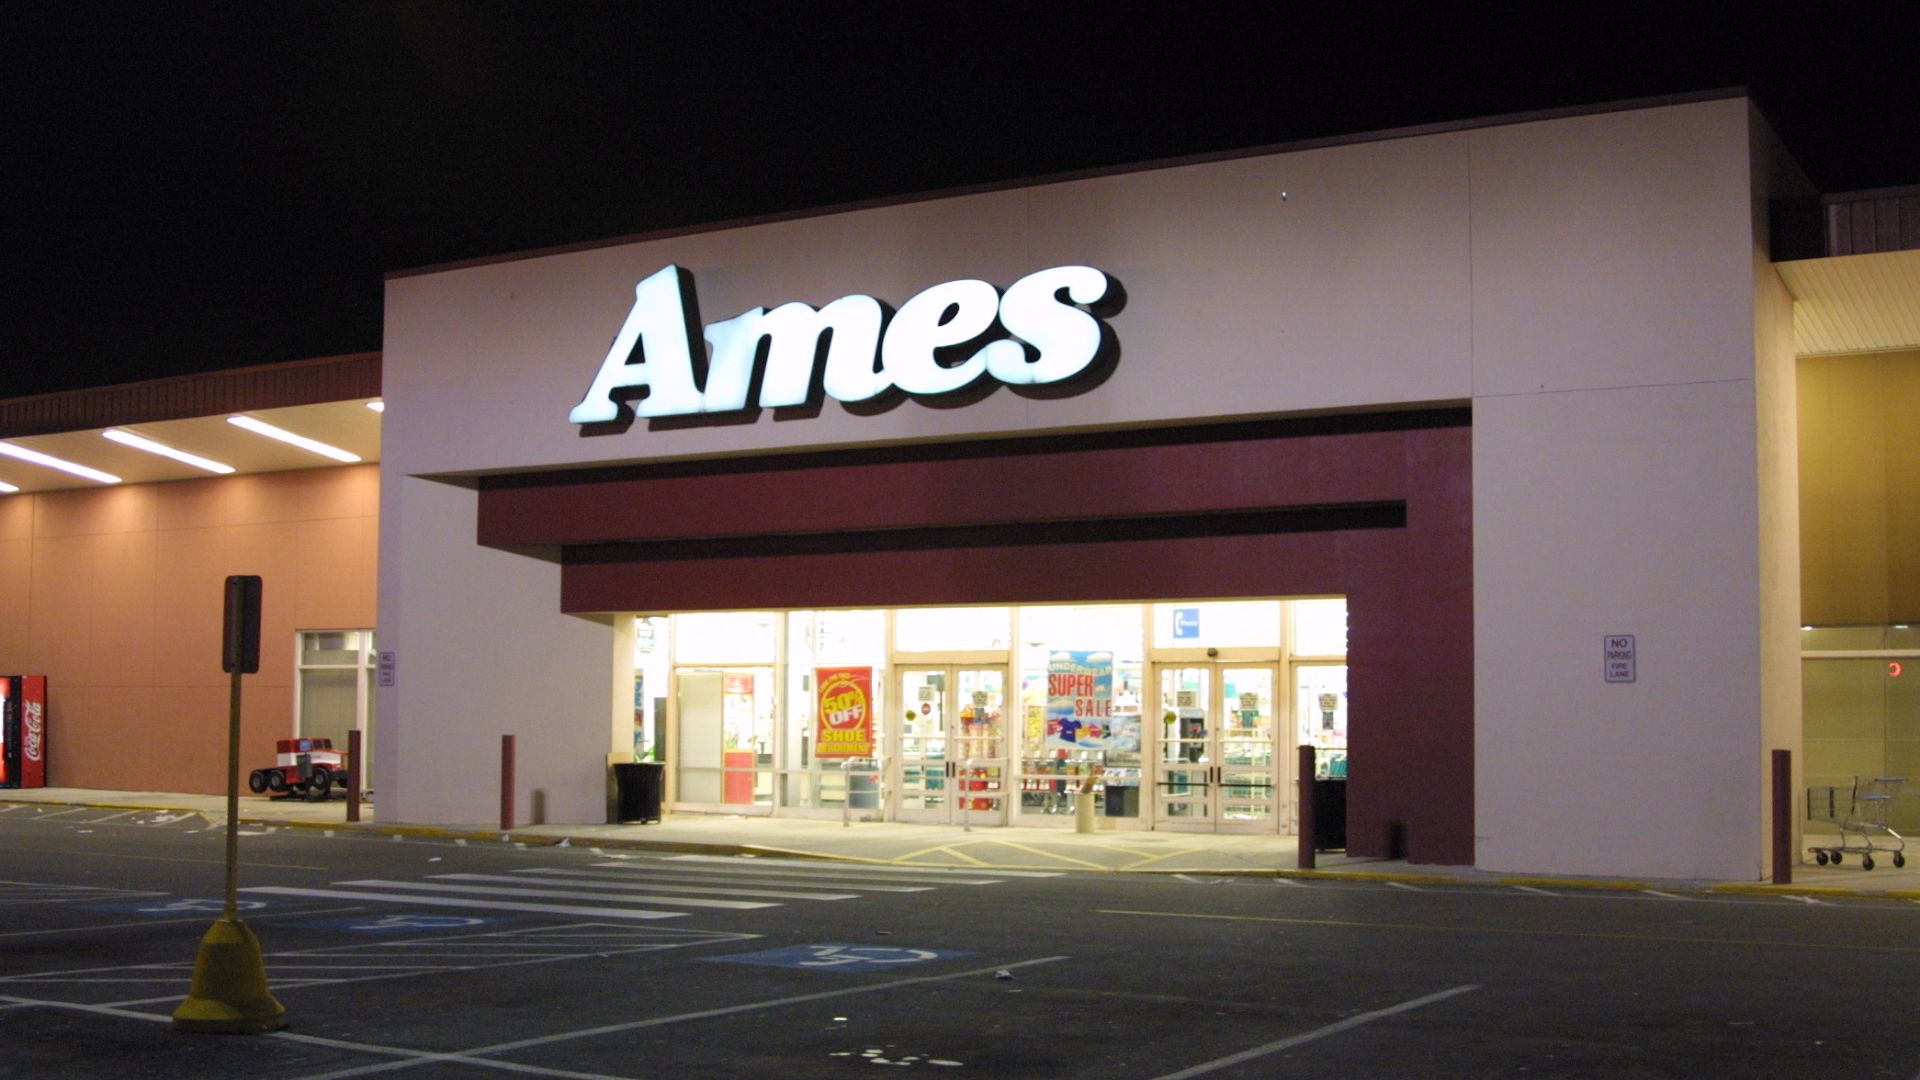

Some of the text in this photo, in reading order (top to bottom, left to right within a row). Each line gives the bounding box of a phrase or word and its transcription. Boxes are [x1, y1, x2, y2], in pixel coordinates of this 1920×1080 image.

[569, 264, 1108, 425] Ames
[1611, 638, 1628, 648] NO
[1048, 674, 1093, 697] SUPER
[823, 691, 865, 714] 50%
[1075, 698, 1112, 717] SALE
[829, 705, 864, 725] OFF
[822, 730, 865, 742] SHOE
